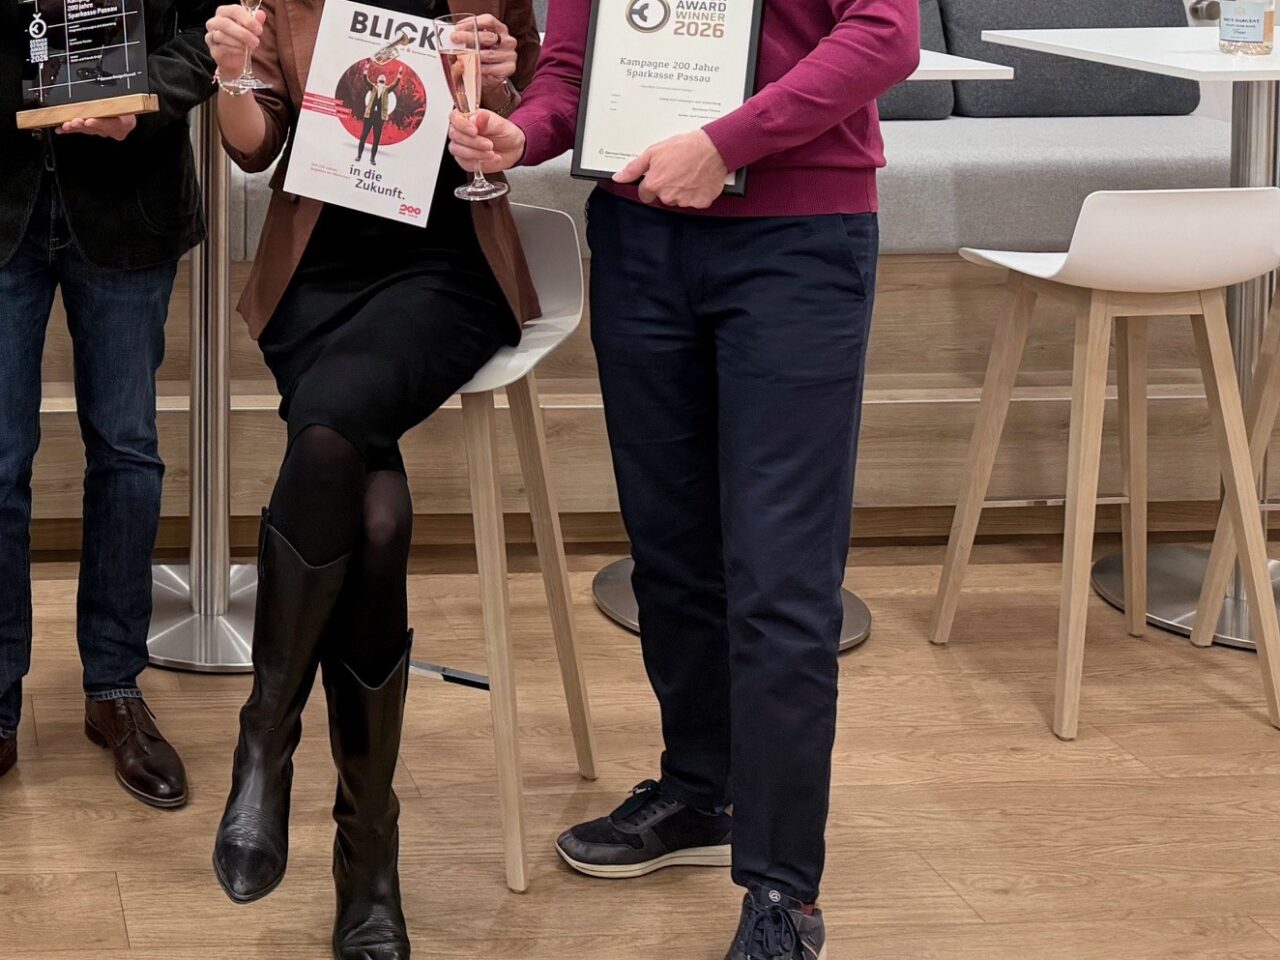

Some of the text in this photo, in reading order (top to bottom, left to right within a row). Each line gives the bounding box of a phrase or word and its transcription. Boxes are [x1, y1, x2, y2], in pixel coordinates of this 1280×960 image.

[675, 0, 727, 12] AWARD
[675, 11, 726, 22] WINNER
[350, 10, 438, 51] BLICK
[673, 21, 725, 38] 2026
[619, 57, 720, 73] Kampagne 200 Jahre
[626, 68, 711, 83] Sparkasse Passau
[349, 164, 361, 177] in
[363, 168, 382, 182] die
[354, 178, 406, 200] Zukunft.
